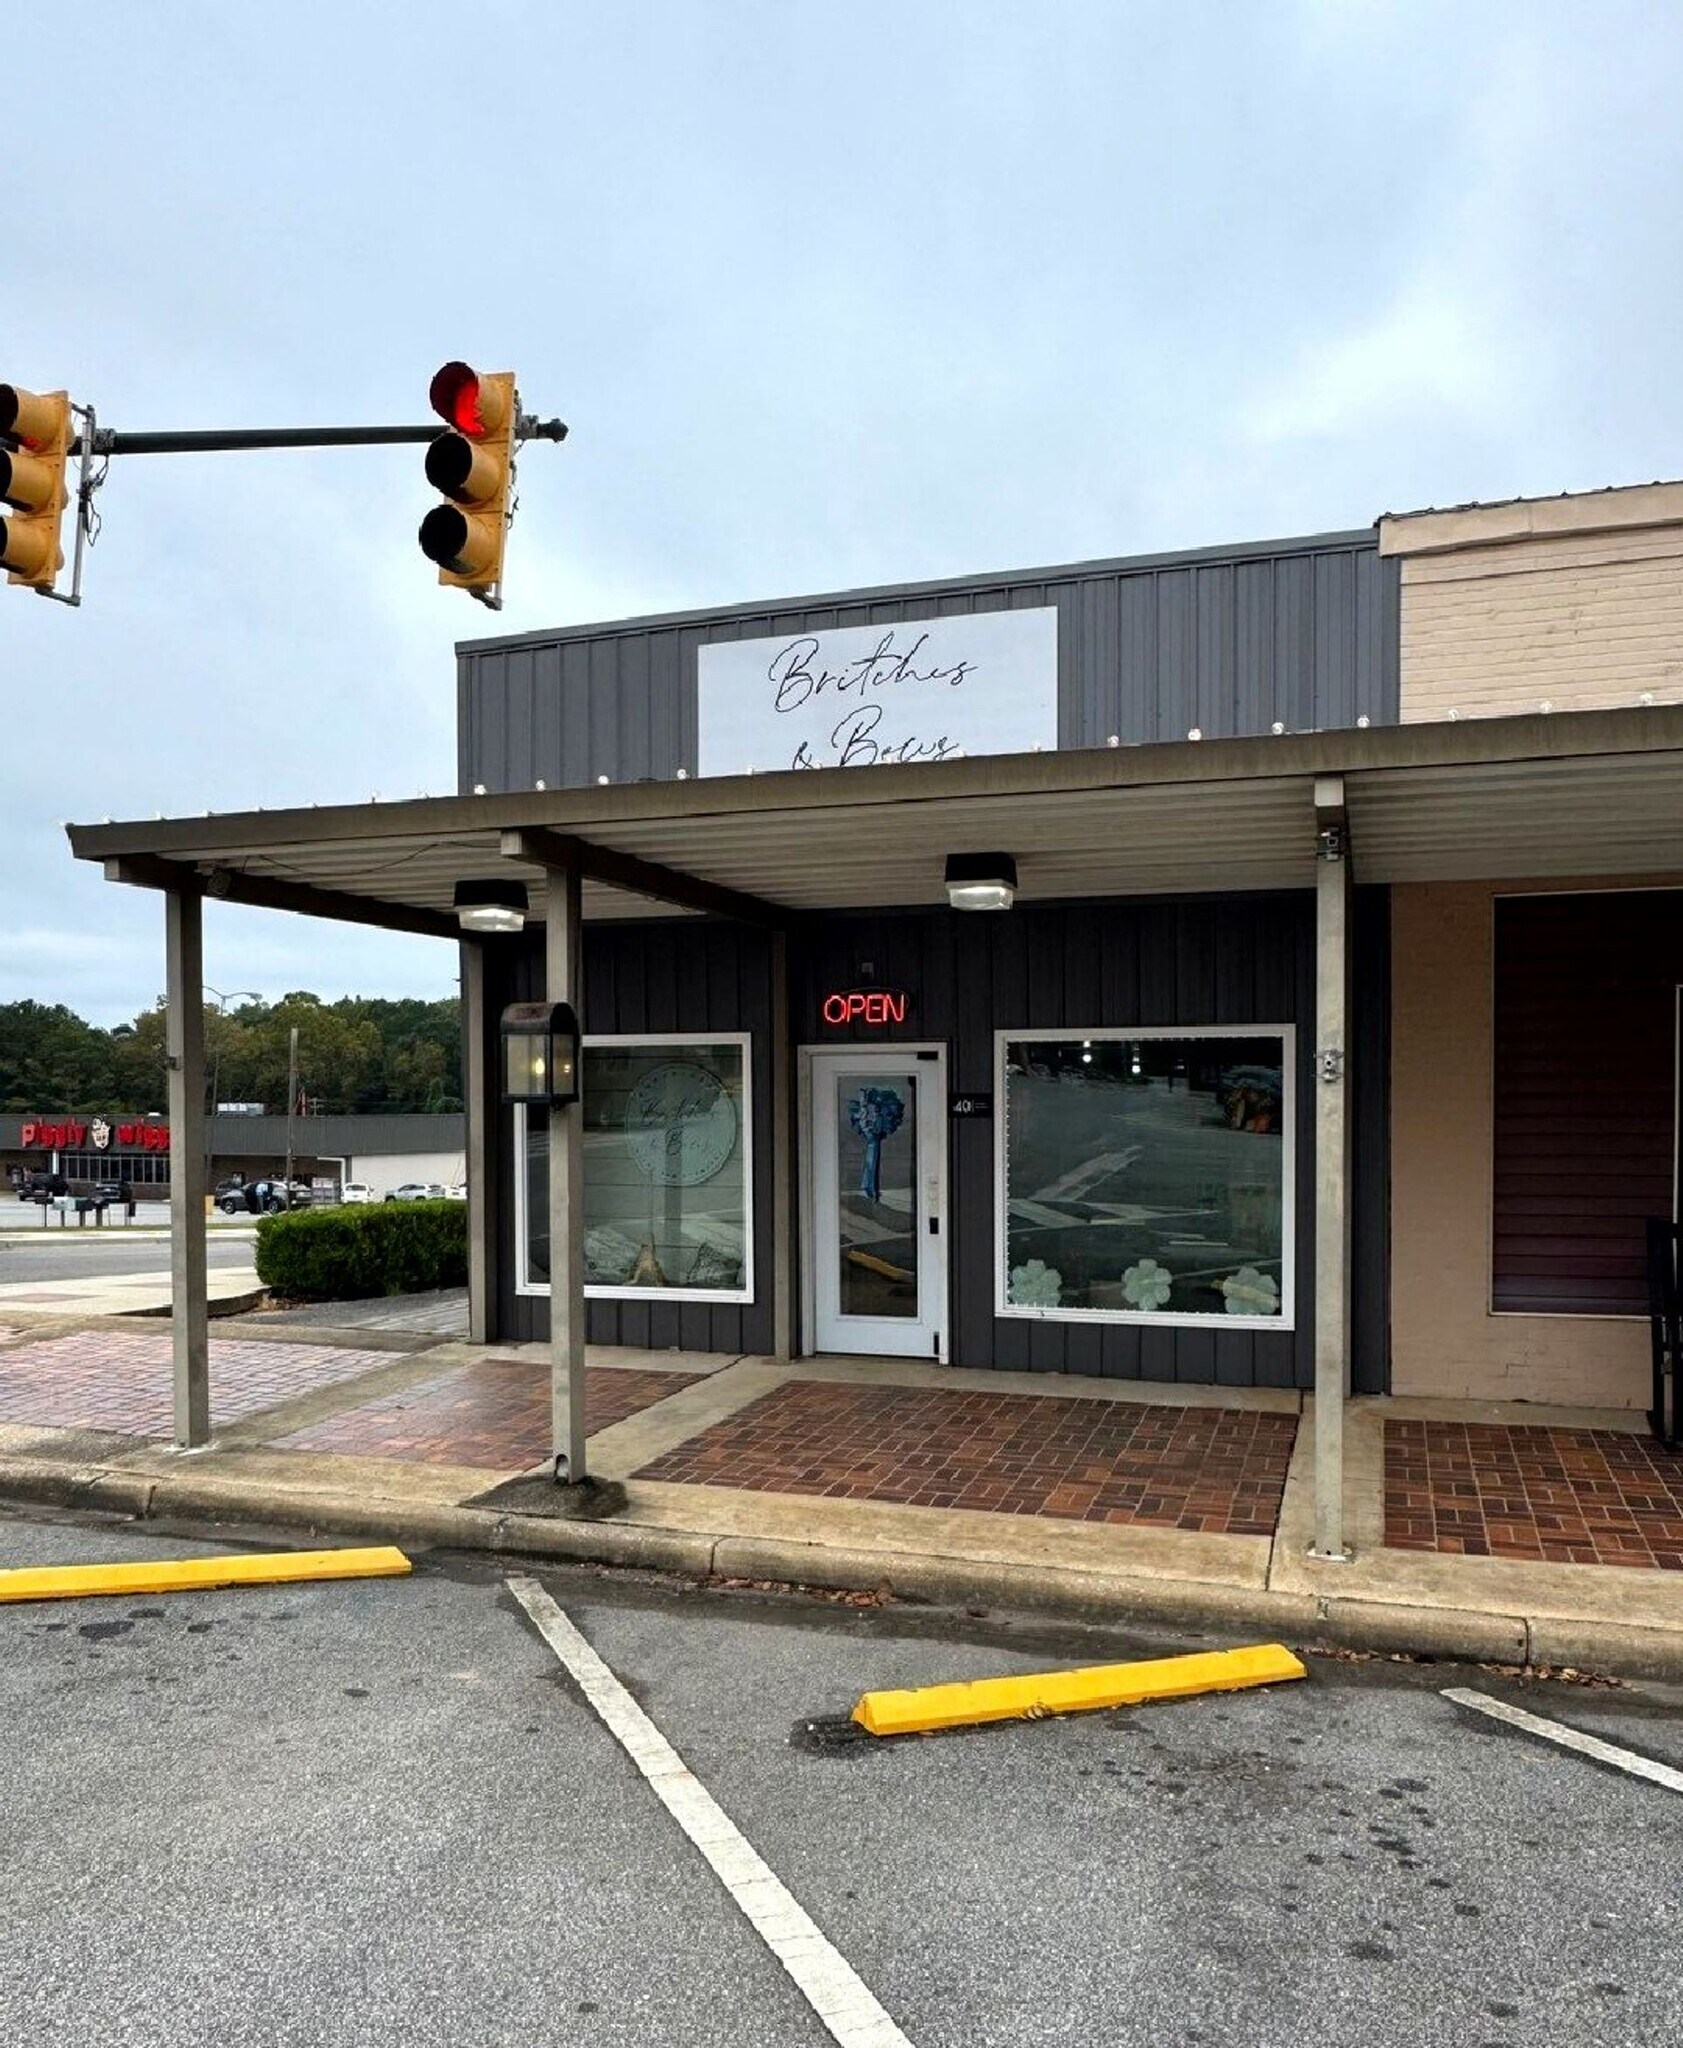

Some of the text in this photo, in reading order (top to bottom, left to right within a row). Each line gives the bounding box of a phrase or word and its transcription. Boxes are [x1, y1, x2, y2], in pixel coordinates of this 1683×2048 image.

[768, 631, 980, 712] Britches
[824, 993, 905, 1023] OPEN
[117, 1117, 170, 1149] wigg
